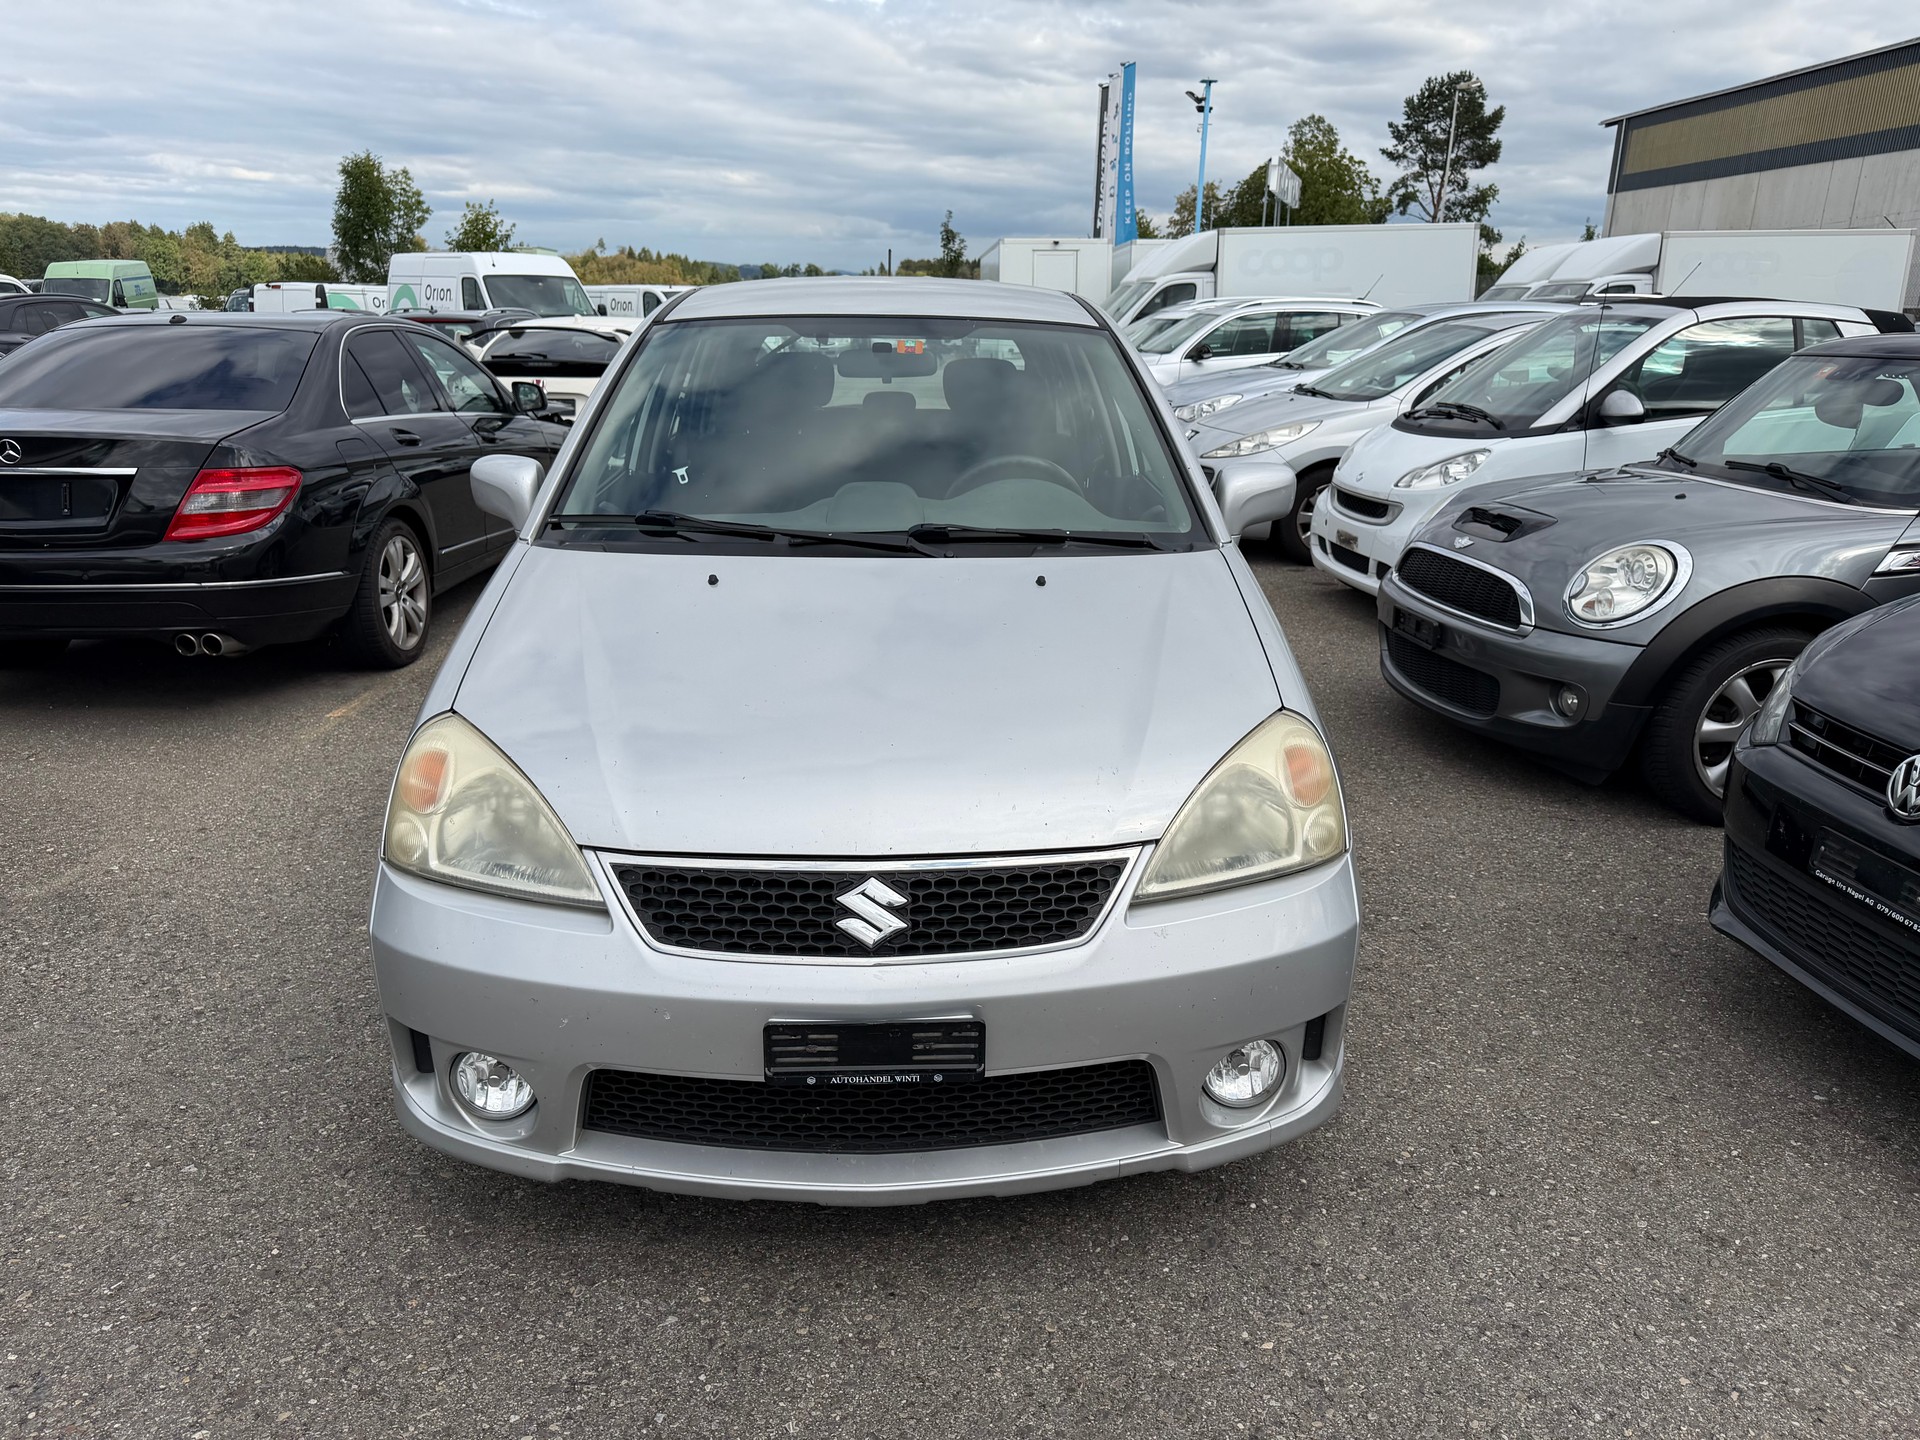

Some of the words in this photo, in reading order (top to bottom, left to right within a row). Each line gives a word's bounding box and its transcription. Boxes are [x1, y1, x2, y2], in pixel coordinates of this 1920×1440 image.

[1124, 163, 1132, 182] ON
[1124, 189, 1132, 225] KEEP
[1815, 869, 1835, 884] Garage
[1836, 881, 1847, 890] Urs
[1847, 887, 1865, 901] Nagel
[1864, 897, 1875, 906] AG
[1876, 903, 1904, 922] 079/600
[830, 1075, 893, 1084] AUTOHANDEL
[895, 1075, 920, 1083] WINTI
